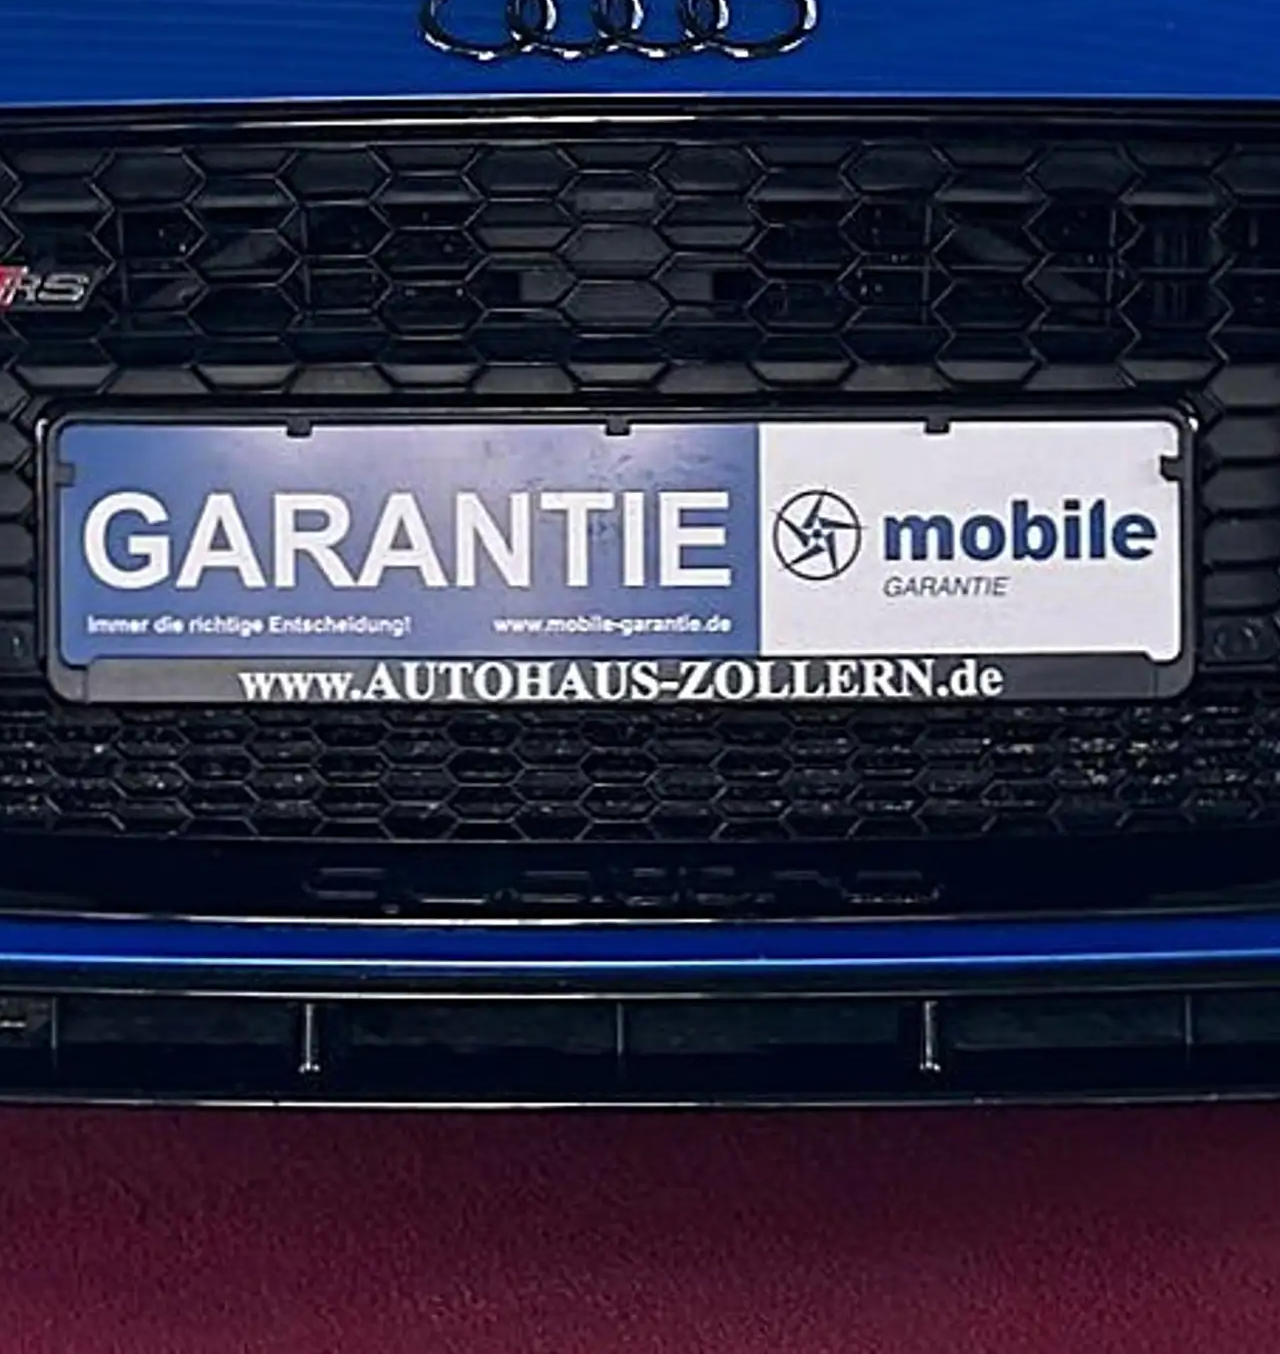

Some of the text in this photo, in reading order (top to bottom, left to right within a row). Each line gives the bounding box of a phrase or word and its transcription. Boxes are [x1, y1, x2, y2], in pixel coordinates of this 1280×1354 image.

[82, 491, 732, 589] GARANTIE
[883, 499, 1158, 561] mobile
[883, 576, 1011, 597] GARANTIE
[87, 615, 412, 638] Immer die richtige Entscheidung!
[493, 616, 732, 637] www.mobile-garantie.de
[238, 658, 1005, 702] www.AUTOHAUS-ZOLLERN.de
